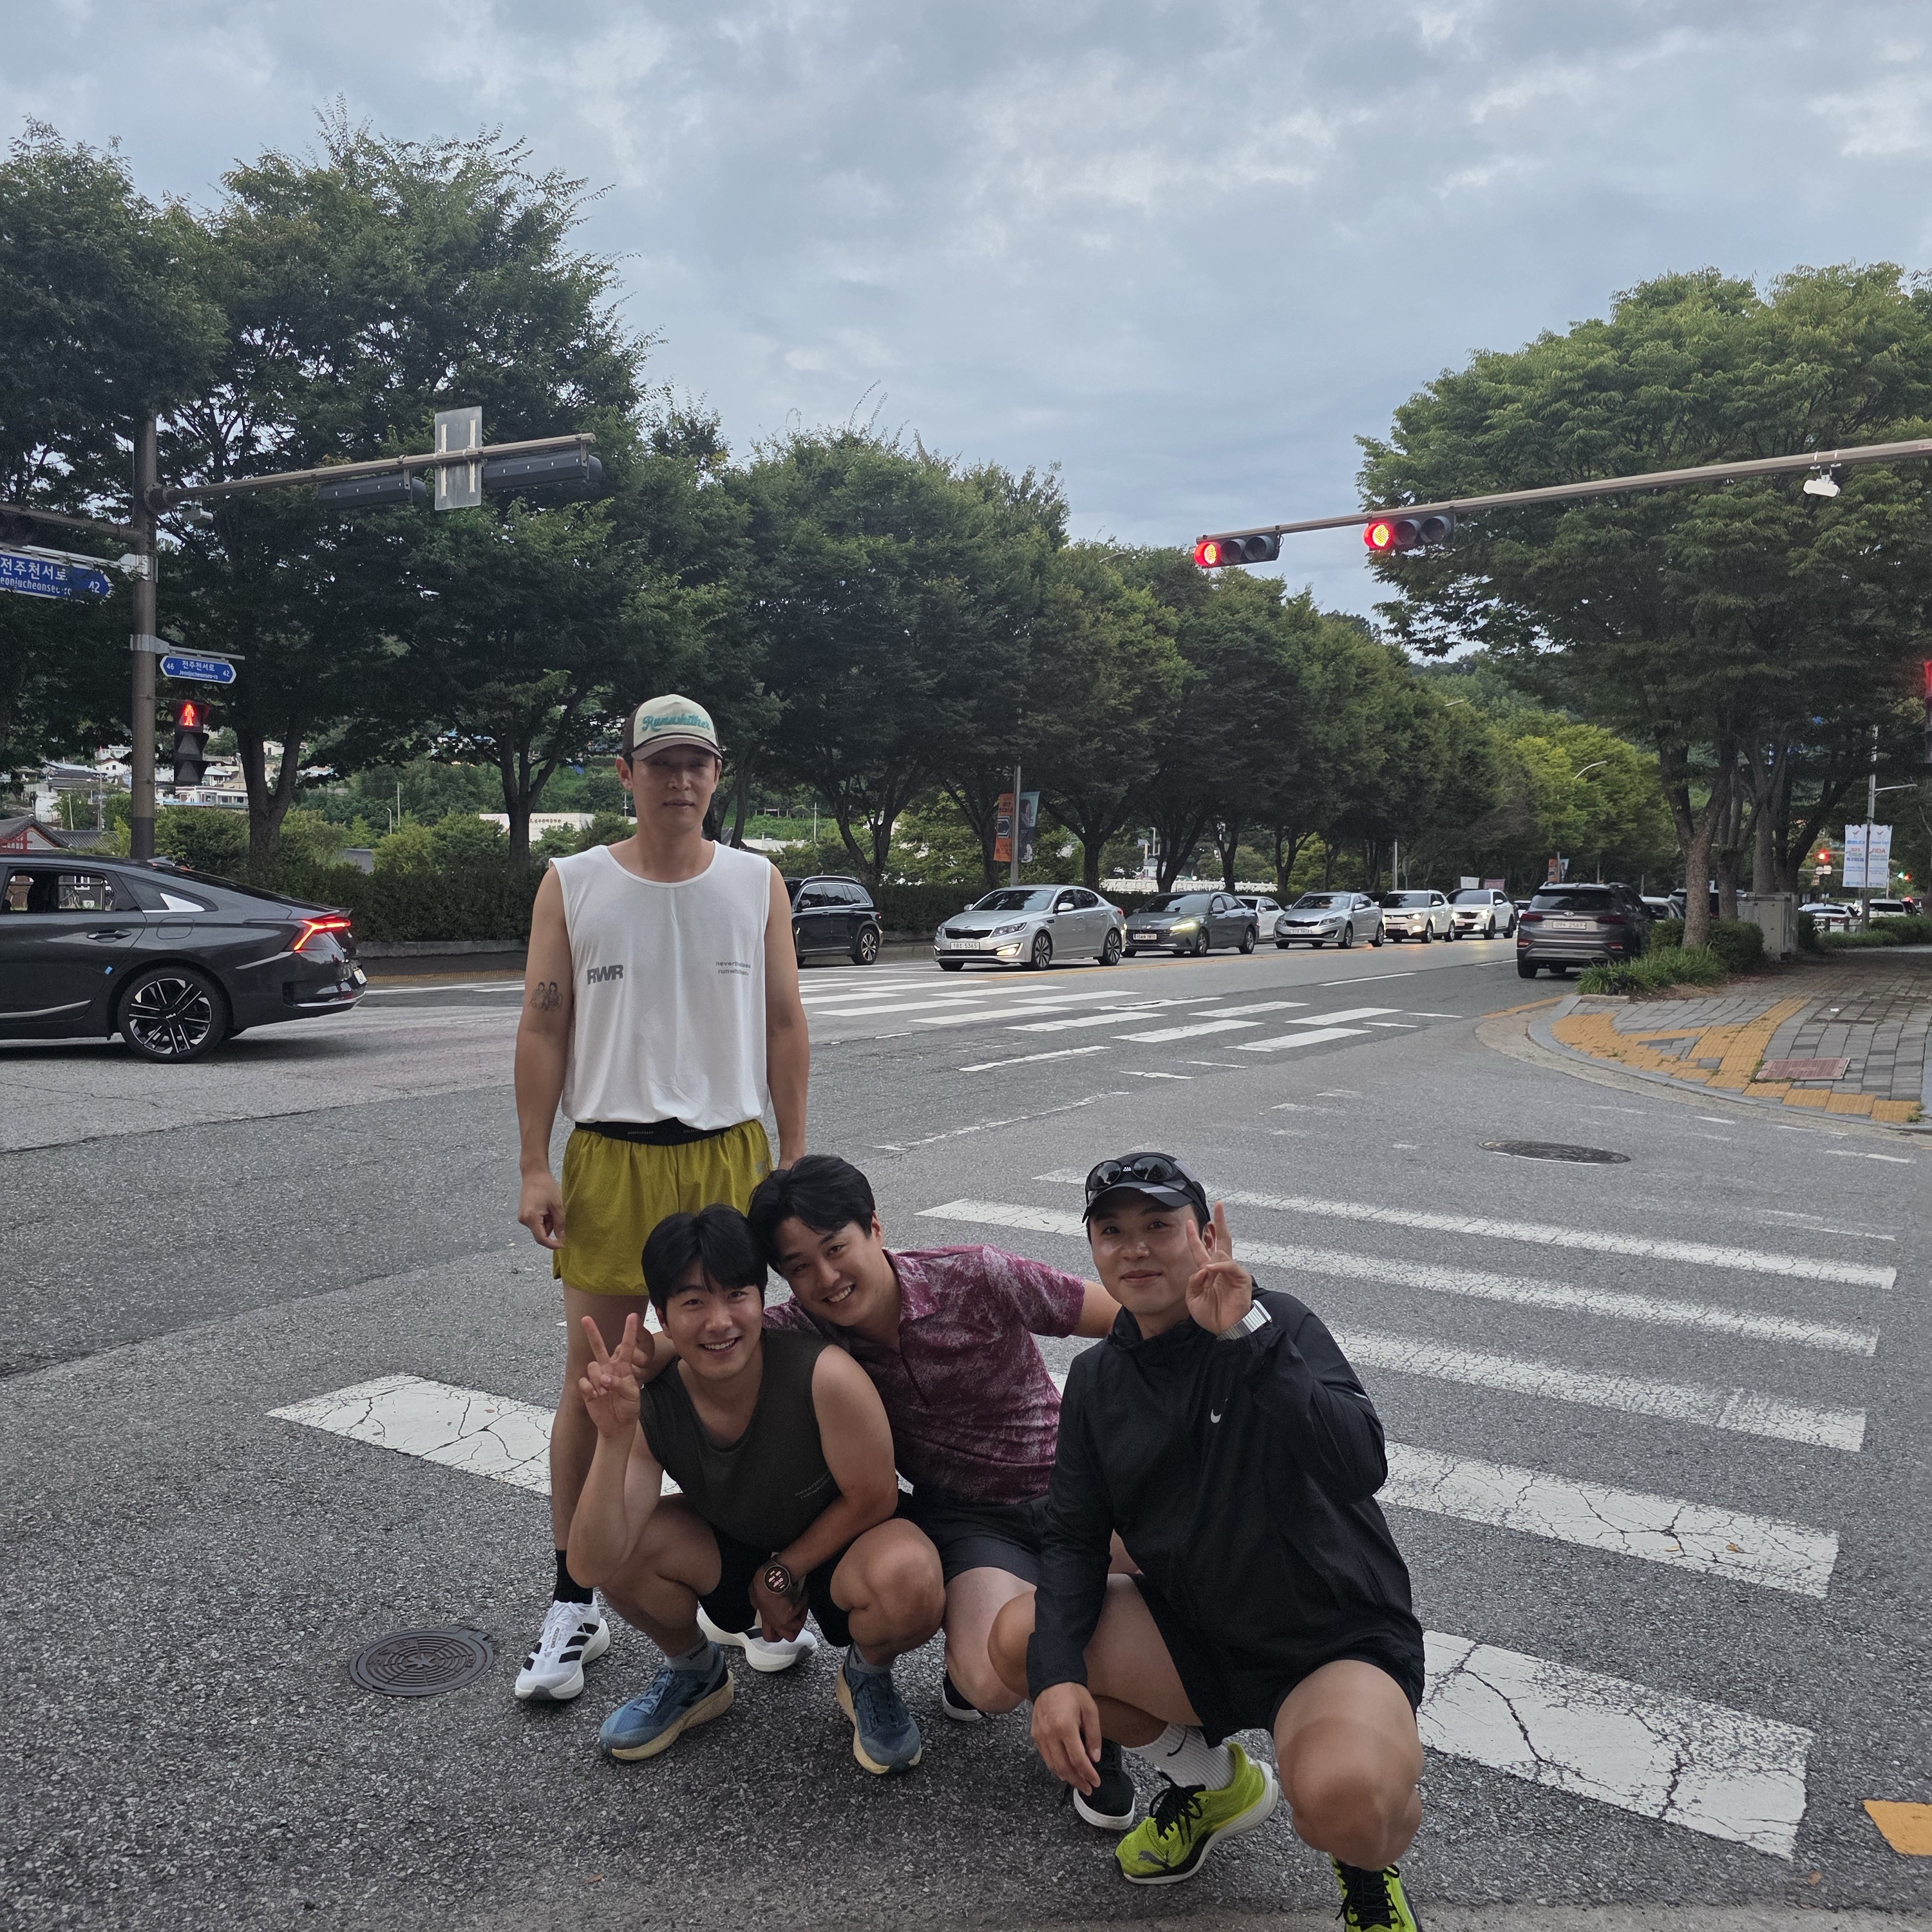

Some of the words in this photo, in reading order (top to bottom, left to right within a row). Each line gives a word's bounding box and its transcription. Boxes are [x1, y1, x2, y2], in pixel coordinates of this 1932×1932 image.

[1, 557, 68, 581] 전주천서로
[88, 580, 100, 594] 42
[182, 660, 215, 672] 전주천서로
[587, 964, 624, 985] RWR
